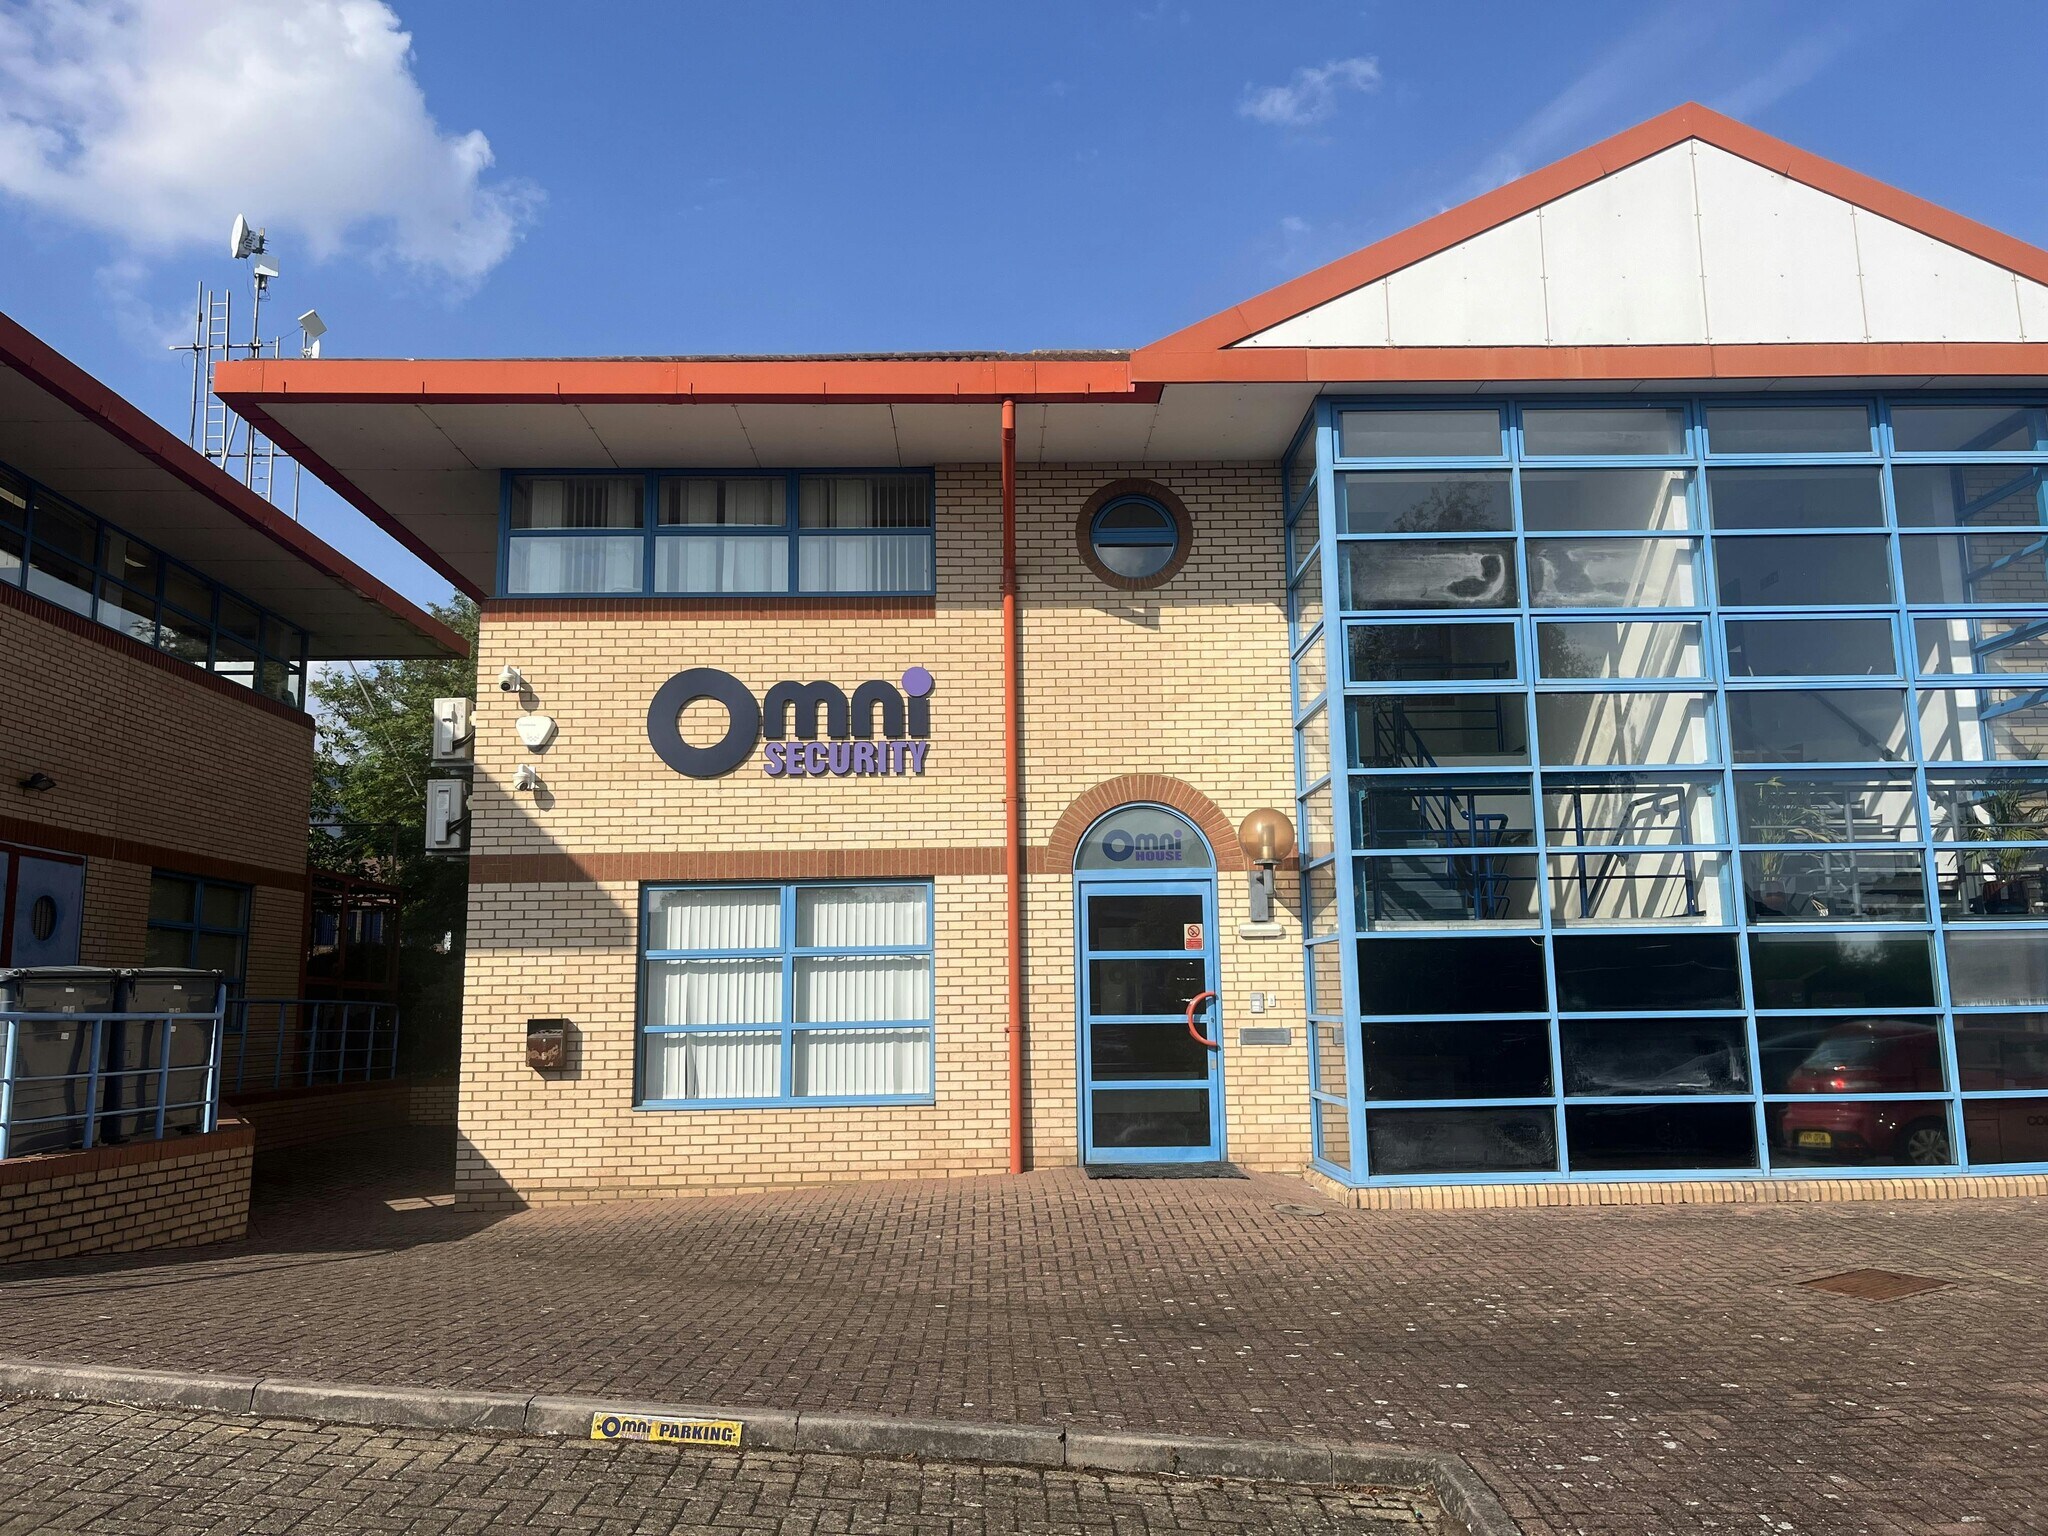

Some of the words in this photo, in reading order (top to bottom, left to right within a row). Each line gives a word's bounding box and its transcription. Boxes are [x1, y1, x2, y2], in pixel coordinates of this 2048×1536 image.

[647, 666, 932, 779] Omni
[763, 740, 929, 776] SECURITY
[1102, 829, 1182, 861] Omni
[1135, 851, 1182, 861] HOUSE
[602, 1417, 652, 1437] Omni
[660, 1424, 733, 1441] PARKING
